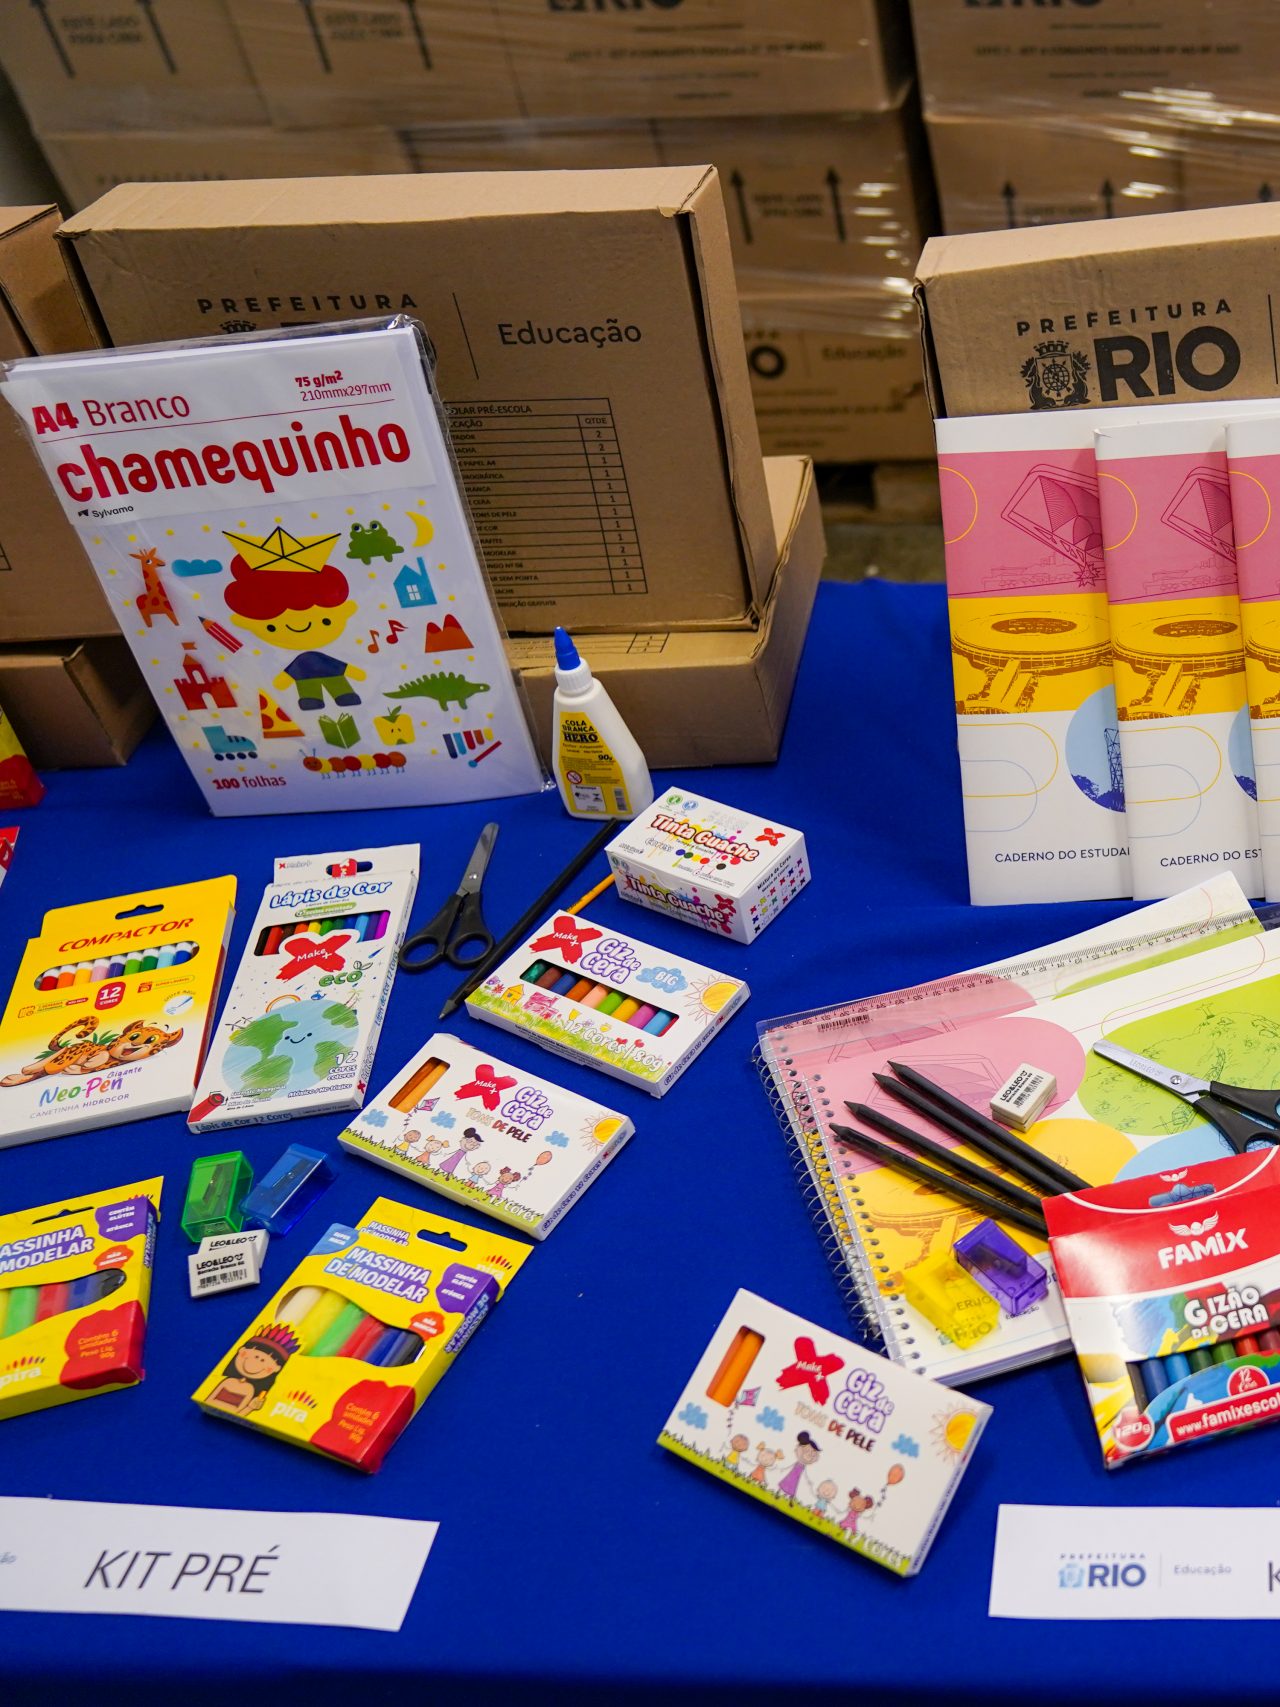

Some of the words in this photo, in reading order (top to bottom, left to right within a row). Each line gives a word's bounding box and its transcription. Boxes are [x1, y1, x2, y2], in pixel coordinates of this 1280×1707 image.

[197, 293, 418, 315] PREFEITURA
[497, 318, 642, 348] Educação
[1016, 298, 1231, 336] PREFEITURA
[1093, 325, 1241, 401] RIO
[294, 376, 310, 389] 75
[299, 381, 392, 402] 210mmx297mm
[31, 403, 79, 435] A4
[83, 395, 190, 427] Branco
[56, 414, 411, 502] chamequinho
[91, 504, 134, 520] Sylvamo
[563, 732, 599, 743] HERO
[212, 777, 241, 791] 100
[241, 774, 287, 788] folhas
[650, 814, 697, 841] Tinta
[693, 829, 760, 861] Guache
[995, 851, 1054, 863] CADERNO
[1058, 849, 1077, 860] DO
[1080, 846, 1131, 859] ESTUDA
[1160, 852, 1219, 867] CADERNO
[1223, 850, 1241, 861] DO
[269, 886, 322, 909] Lápis
[322, 883, 350, 900] de
[351, 880, 393, 897] Cor
[627, 876, 667, 902] Tinta
[665, 893, 726, 922] Guache
[58, 917, 195, 953] COMPACTOR
[579, 952, 631, 984] Cera
[596, 938, 635, 961] Giz
[623, 955, 642, 972] de
[100, 986, 121, 1000] 12
[318, 969, 364, 988] eco
[655, 970, 680, 986] BIG
[565, 1019, 583, 1035] 12
[582, 1026, 627, 1054] Cores
[106, 1066, 144, 1080] Gigante
[334, 1050, 359, 1066] 12
[29, 1103, 80, 1120] CANETINHA
[82, 1093, 130, 1108] HIDROCOR
[39, 1076, 123, 1108] Neo-Pen
[514, 1086, 550, 1109] Giz
[538, 1103, 553, 1118] de
[465, 1106, 492, 1128] TONS
[491, 1119, 506, 1133] DE
[505, 1123, 533, 1144] PELE
[501, 1099, 546, 1131] Cera
[488, 1194, 503, 1207] 12
[503, 1198, 537, 1223] Cores
[0, 1225, 85, 1259] ASSINHA
[368, 1221, 410, 1240] MASSINHA
[196, 1255, 234, 1270] LEO&LEO
[346, 1246, 432, 1285] MASSINHA
[324, 1258, 351, 1277] DE
[347, 1264, 430, 1303] MODELAR
[1191, 1325, 1210, 1340] DE
[1209, 1304, 1270, 1336] CERA
[846, 1367, 885, 1398] Giz
[876, 1397, 895, 1416] de
[270, 1400, 308, 1423] pira
[833, 1391, 886, 1434] Cera
[83, 1550, 171, 1590] KIT
[171, 1544, 280, 1594] PRÉ
[1059, 1552, 1146, 1560] PREFEITURA
[1088, 1562, 1147, 1588] RIO
[1173, 1562, 1232, 1577] Educação
